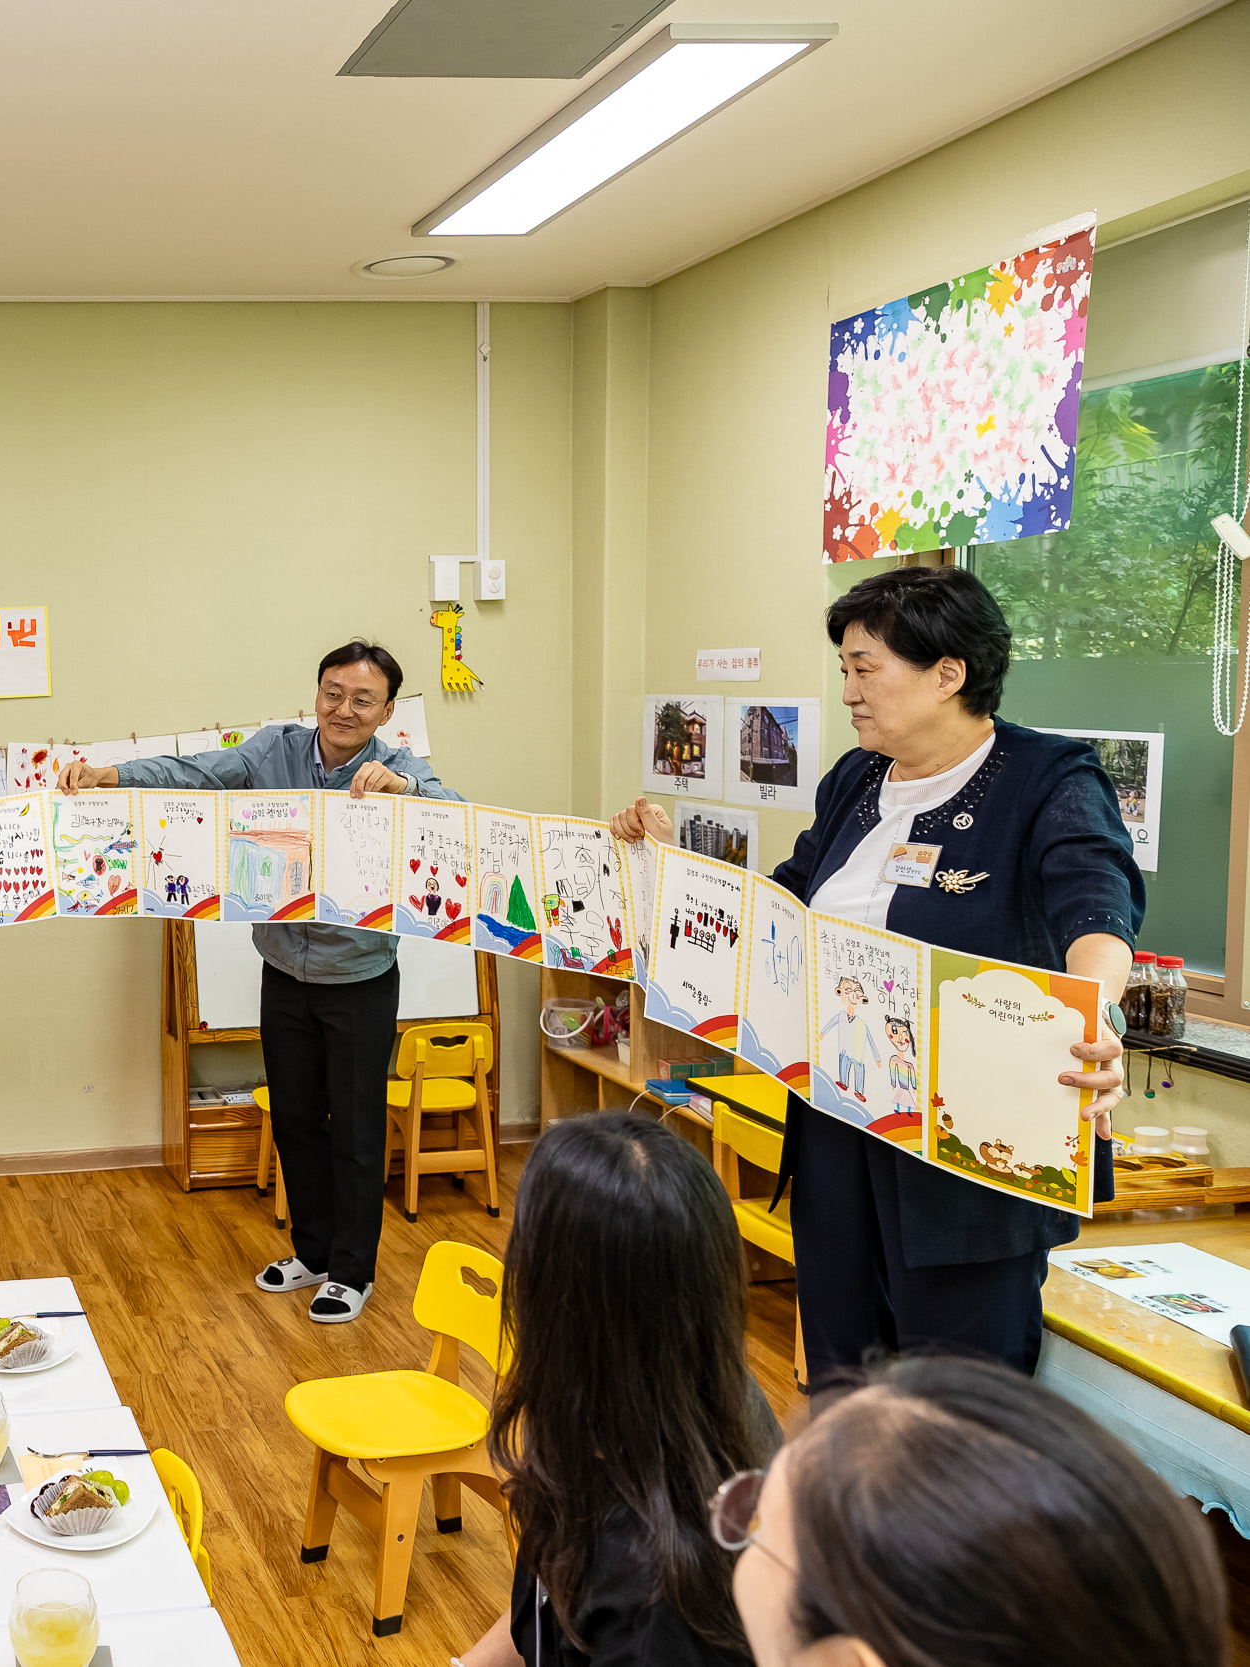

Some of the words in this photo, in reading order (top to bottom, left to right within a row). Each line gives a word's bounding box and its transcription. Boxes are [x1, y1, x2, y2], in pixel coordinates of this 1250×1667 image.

[697, 658, 714, 669] 우리가
[717, 659, 728, 669] 사는
[731, 658, 744, 669] 집의
[747, 657, 759, 668] 종류
[674, 777, 689, 791] 주택
[759, 785, 777, 800] 빌라
[845, 938, 861, 948] 김경호
[864, 943, 891, 958] 구청장님께
[994, 998, 1021, 1011] 사랑의
[988, 1009, 1025, 1026] 어린이집
